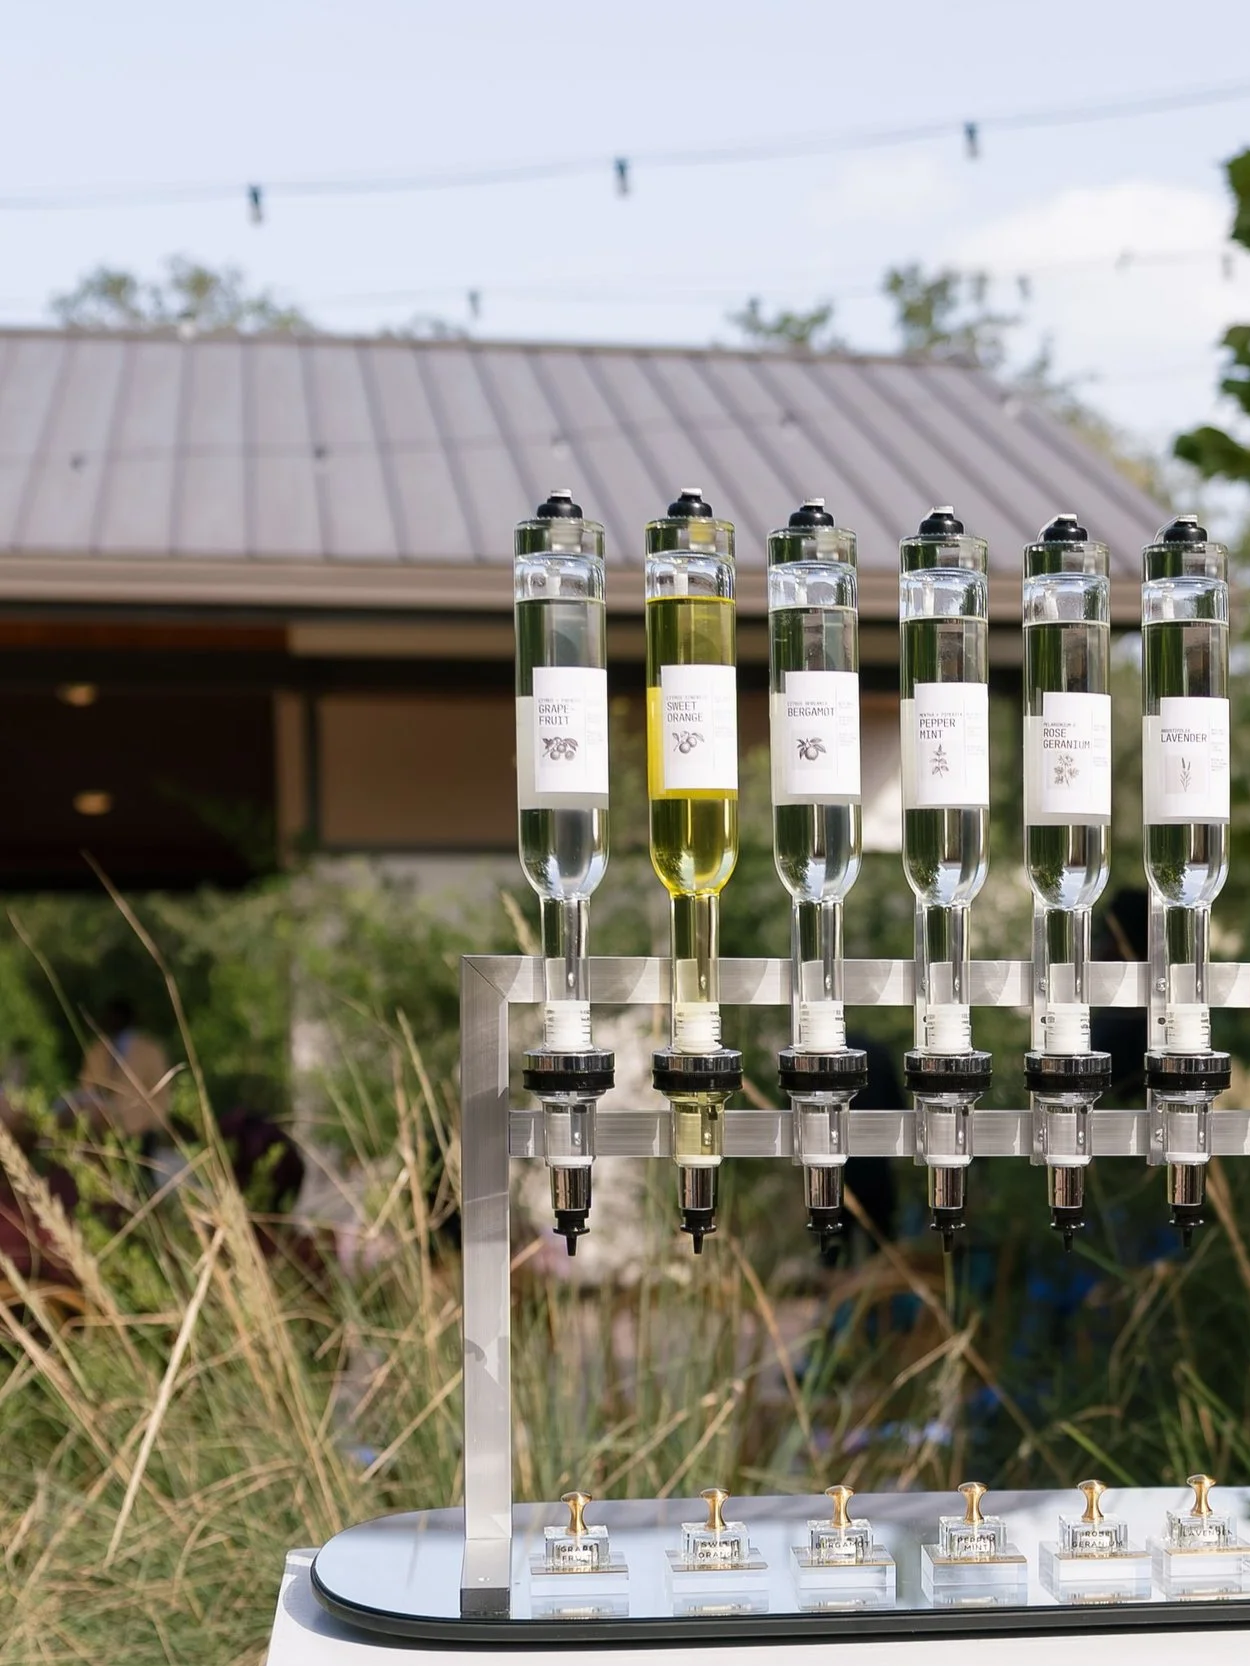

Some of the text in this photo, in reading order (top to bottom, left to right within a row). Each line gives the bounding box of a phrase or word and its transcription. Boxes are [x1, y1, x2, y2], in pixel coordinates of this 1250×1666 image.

[666, 701, 697, 711] SWEET
[667, 712, 703, 722] ORANGE
[787, 707, 835, 717] BERGAMOT
[539, 716, 569, 725] FRUIT
[919, 718, 956, 728] PEPPER
[919, 730, 943, 740] MINT
[1043, 728, 1067, 738] ROSE
[1160, 733, 1207, 743] LAVENDER
[1043, 740, 1090, 749] GERANIUM
